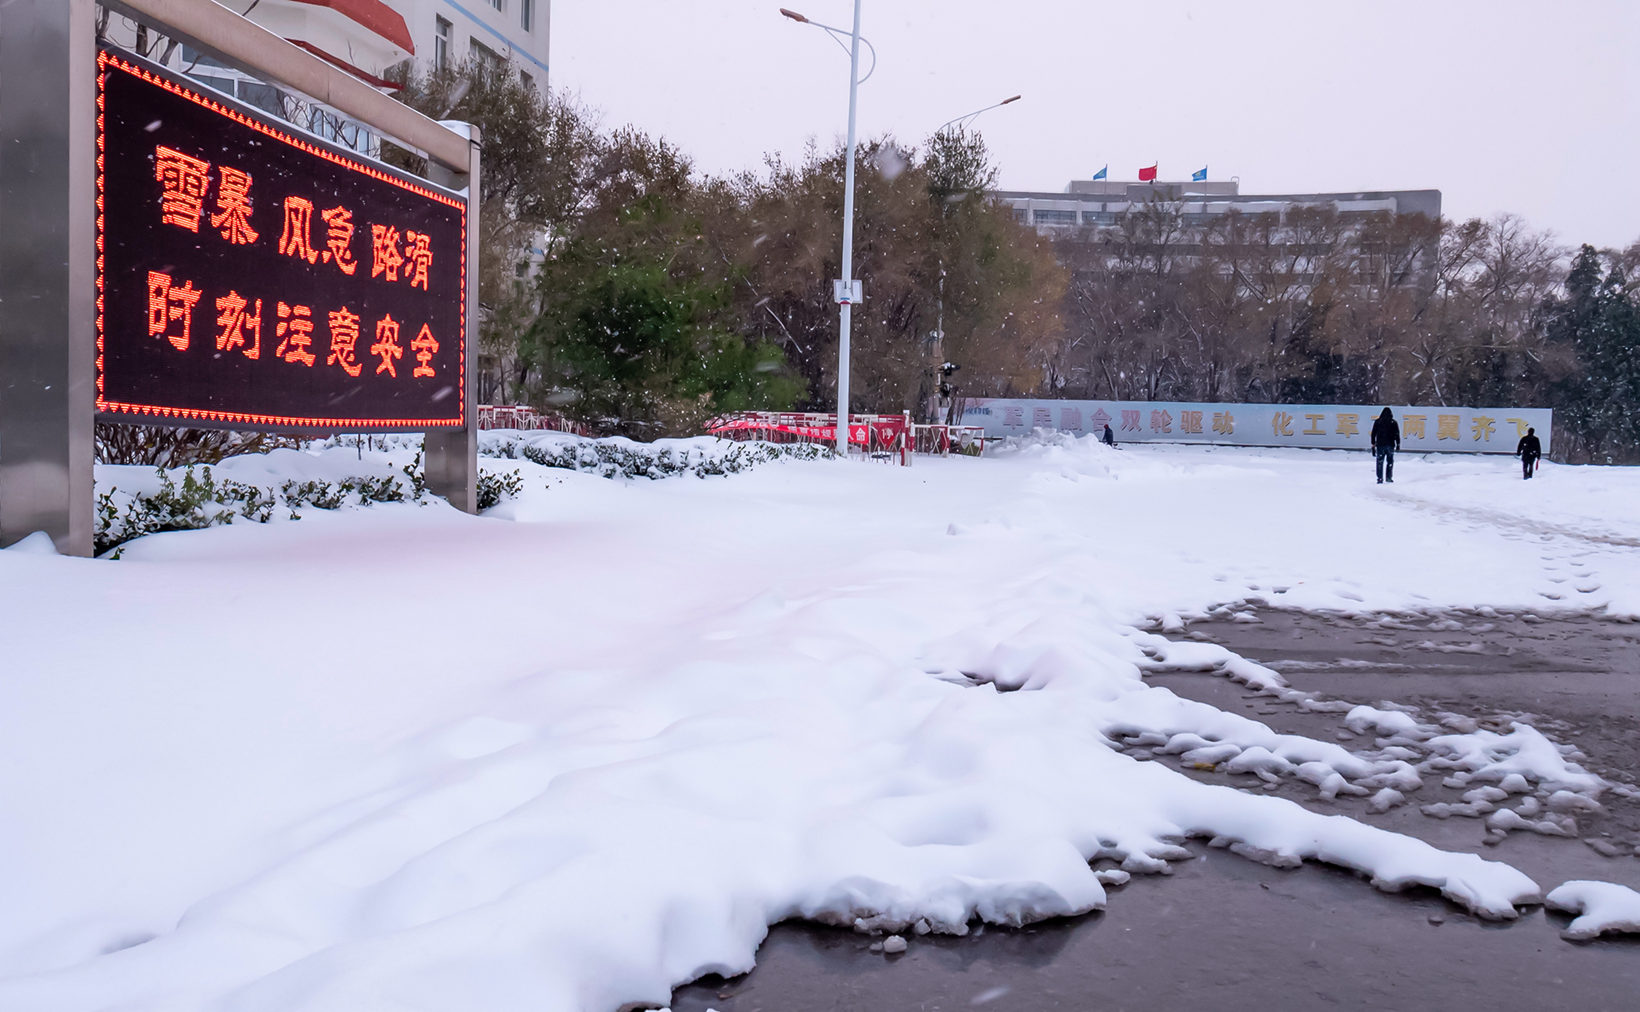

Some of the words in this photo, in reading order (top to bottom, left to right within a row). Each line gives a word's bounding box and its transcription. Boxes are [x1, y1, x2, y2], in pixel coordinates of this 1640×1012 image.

[155, 145, 260, 246] 雪暴
[278, 195, 358, 276] 风急
[371, 223, 434, 291] 路滑
[147, 269, 440, 379] 时刻注意安全
[1271, 410, 1530, 442] 化工军两翼齐飞
